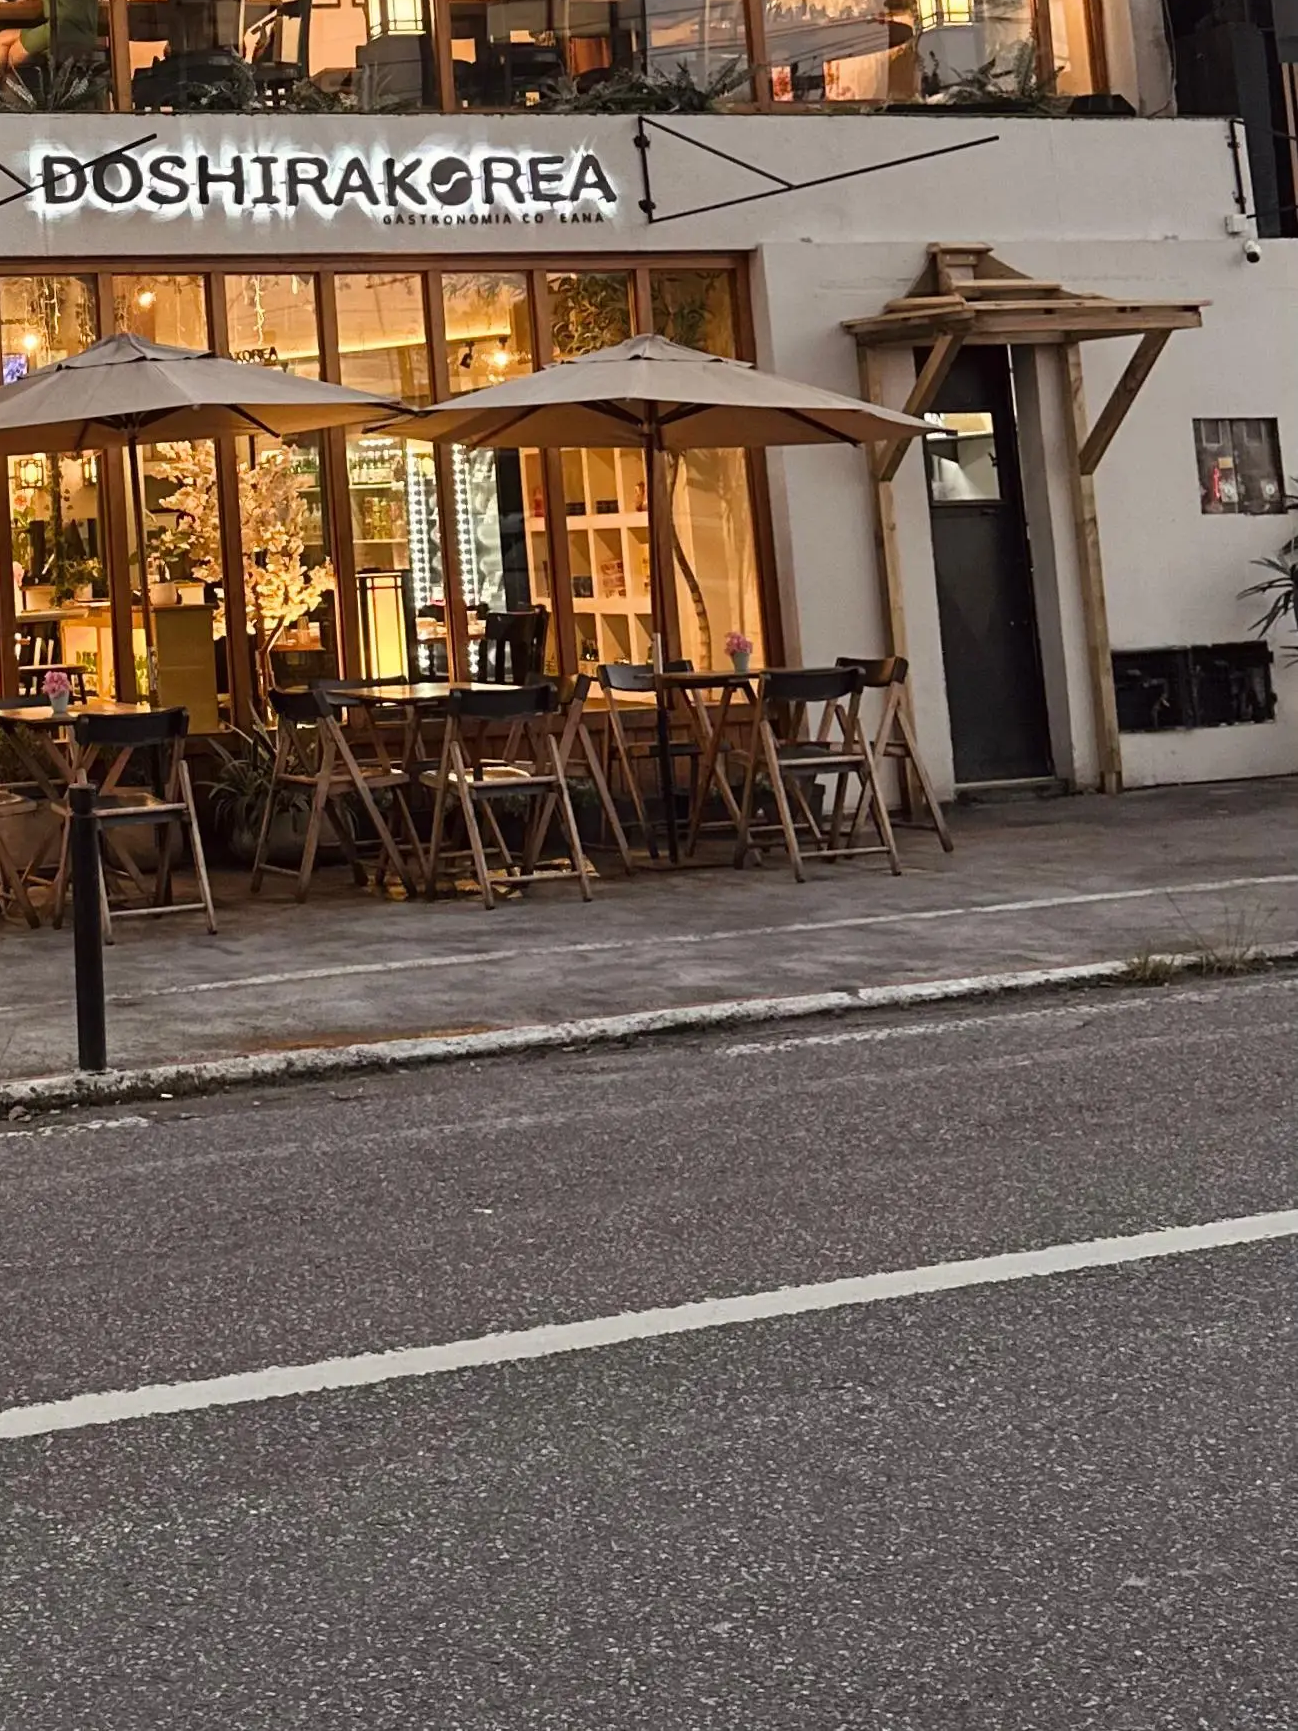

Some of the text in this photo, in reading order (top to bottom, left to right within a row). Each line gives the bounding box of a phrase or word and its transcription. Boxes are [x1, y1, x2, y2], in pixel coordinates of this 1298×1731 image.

[42, 153, 618, 207] DOSHIRAKOREA
[383, 212, 605, 226] GASTRONOMIA COEANA
